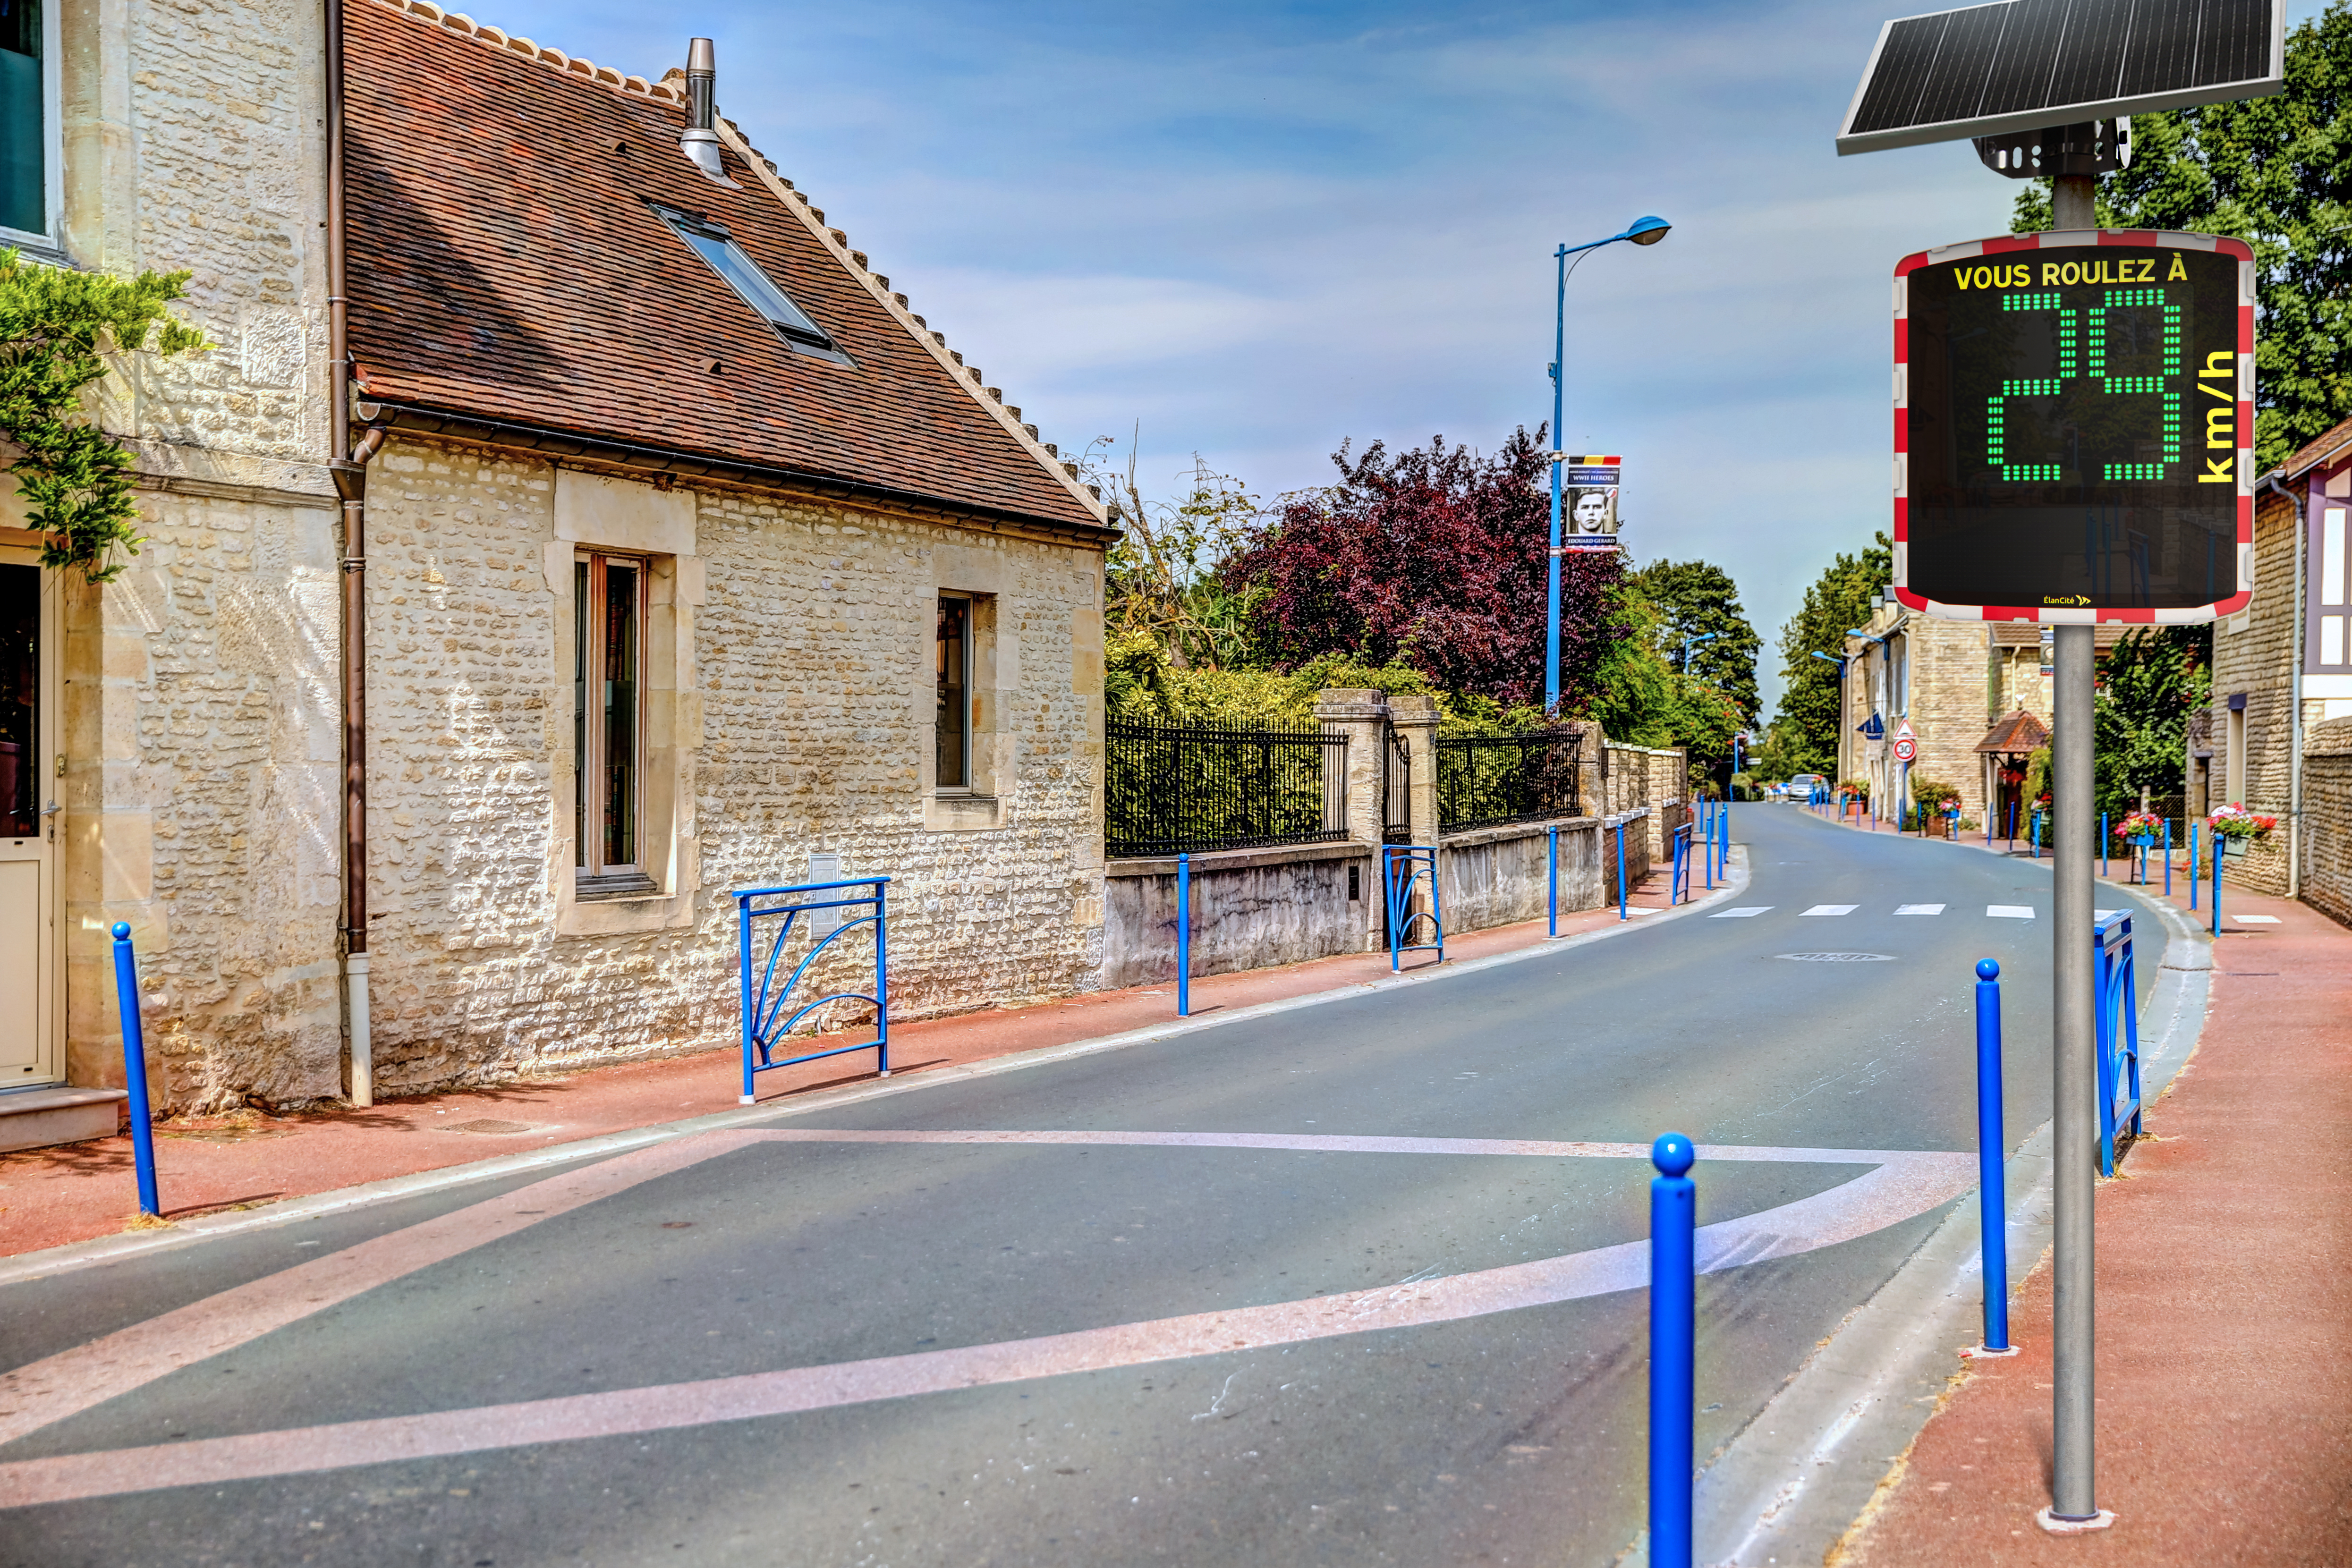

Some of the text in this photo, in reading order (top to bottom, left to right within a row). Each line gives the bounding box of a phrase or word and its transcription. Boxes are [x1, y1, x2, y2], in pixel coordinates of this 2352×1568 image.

[1953, 253, 2188, 290] VOUS ROULEZ À
[1987, 288, 2181, 481] 29
[2198, 351, 2233, 483] km/h
[2044, 595, 2074, 604] ÉlanCité
[1897, 745, 1911, 754] 30
